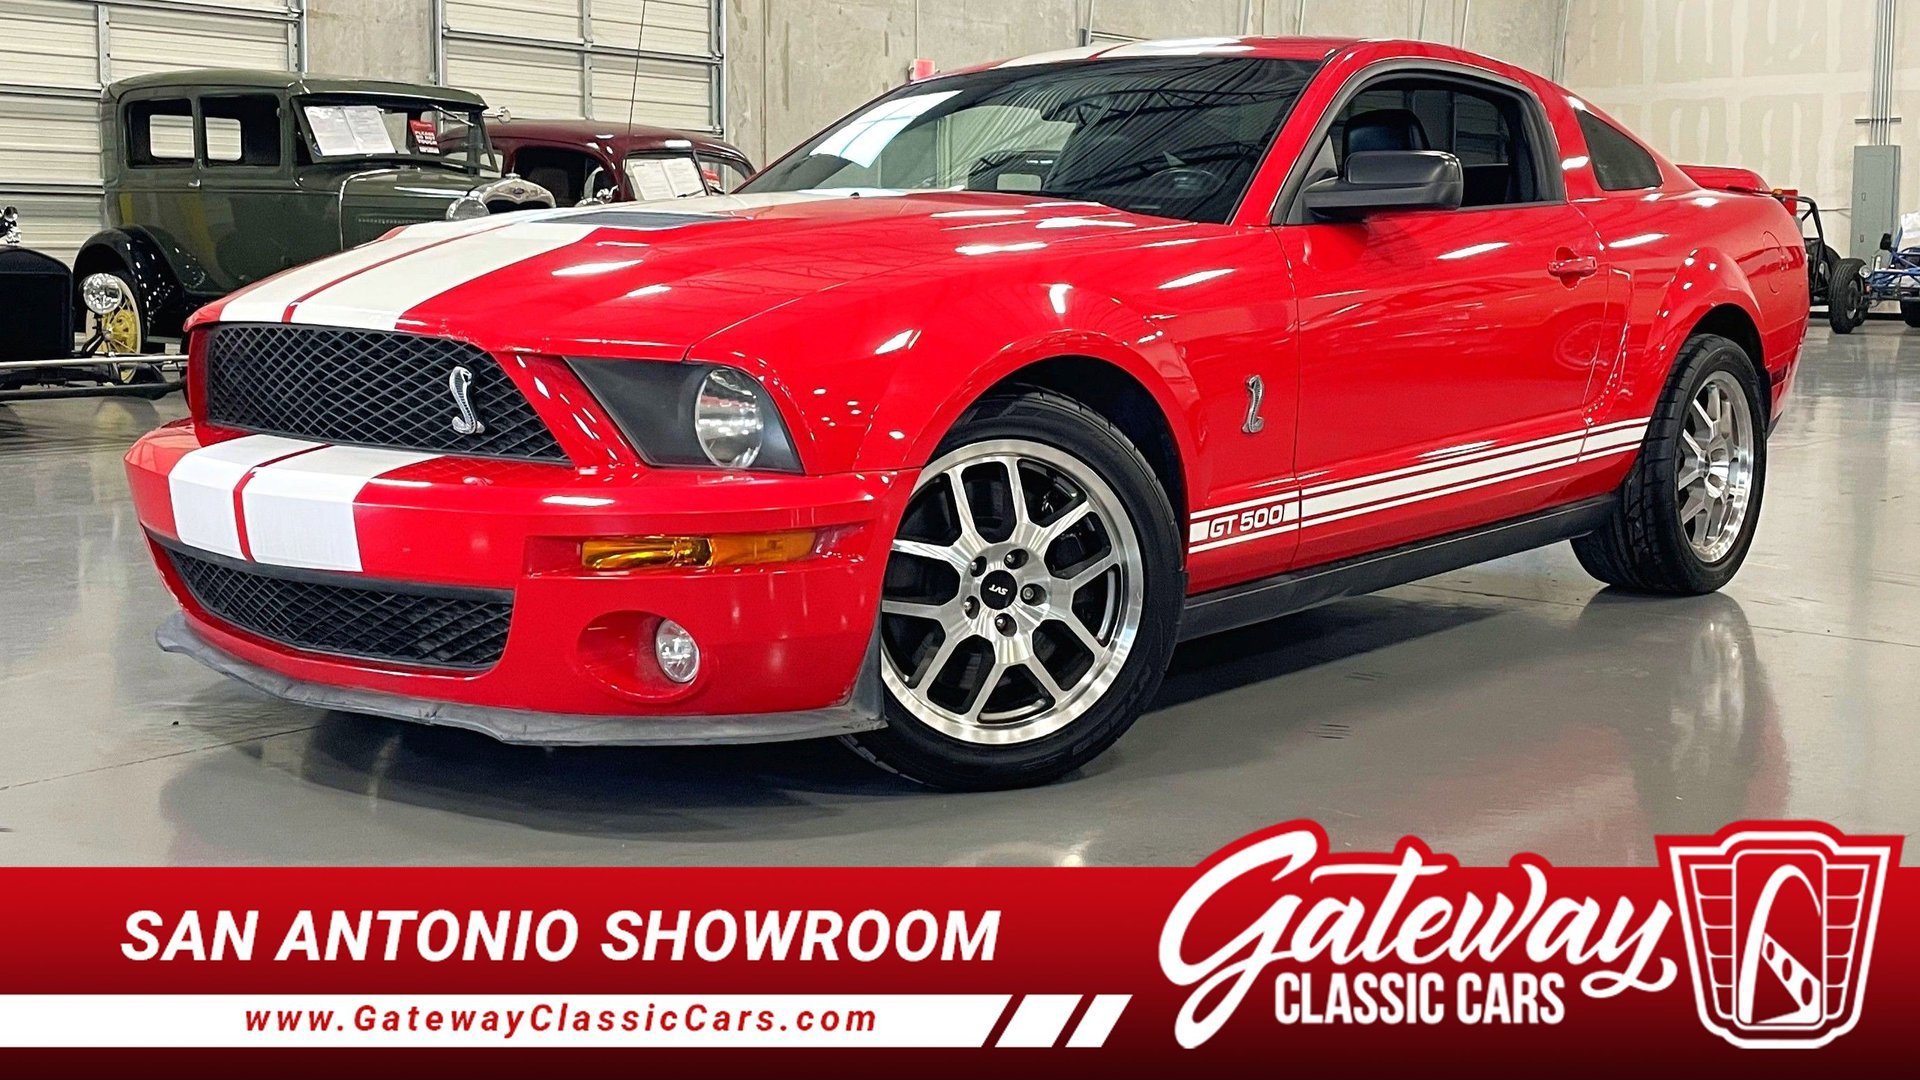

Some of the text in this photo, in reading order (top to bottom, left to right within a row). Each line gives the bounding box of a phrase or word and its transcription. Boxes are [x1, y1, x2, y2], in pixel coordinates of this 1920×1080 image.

[1209, 504, 1284, 539] GT 500
[988, 584, 1009, 596] SVT
